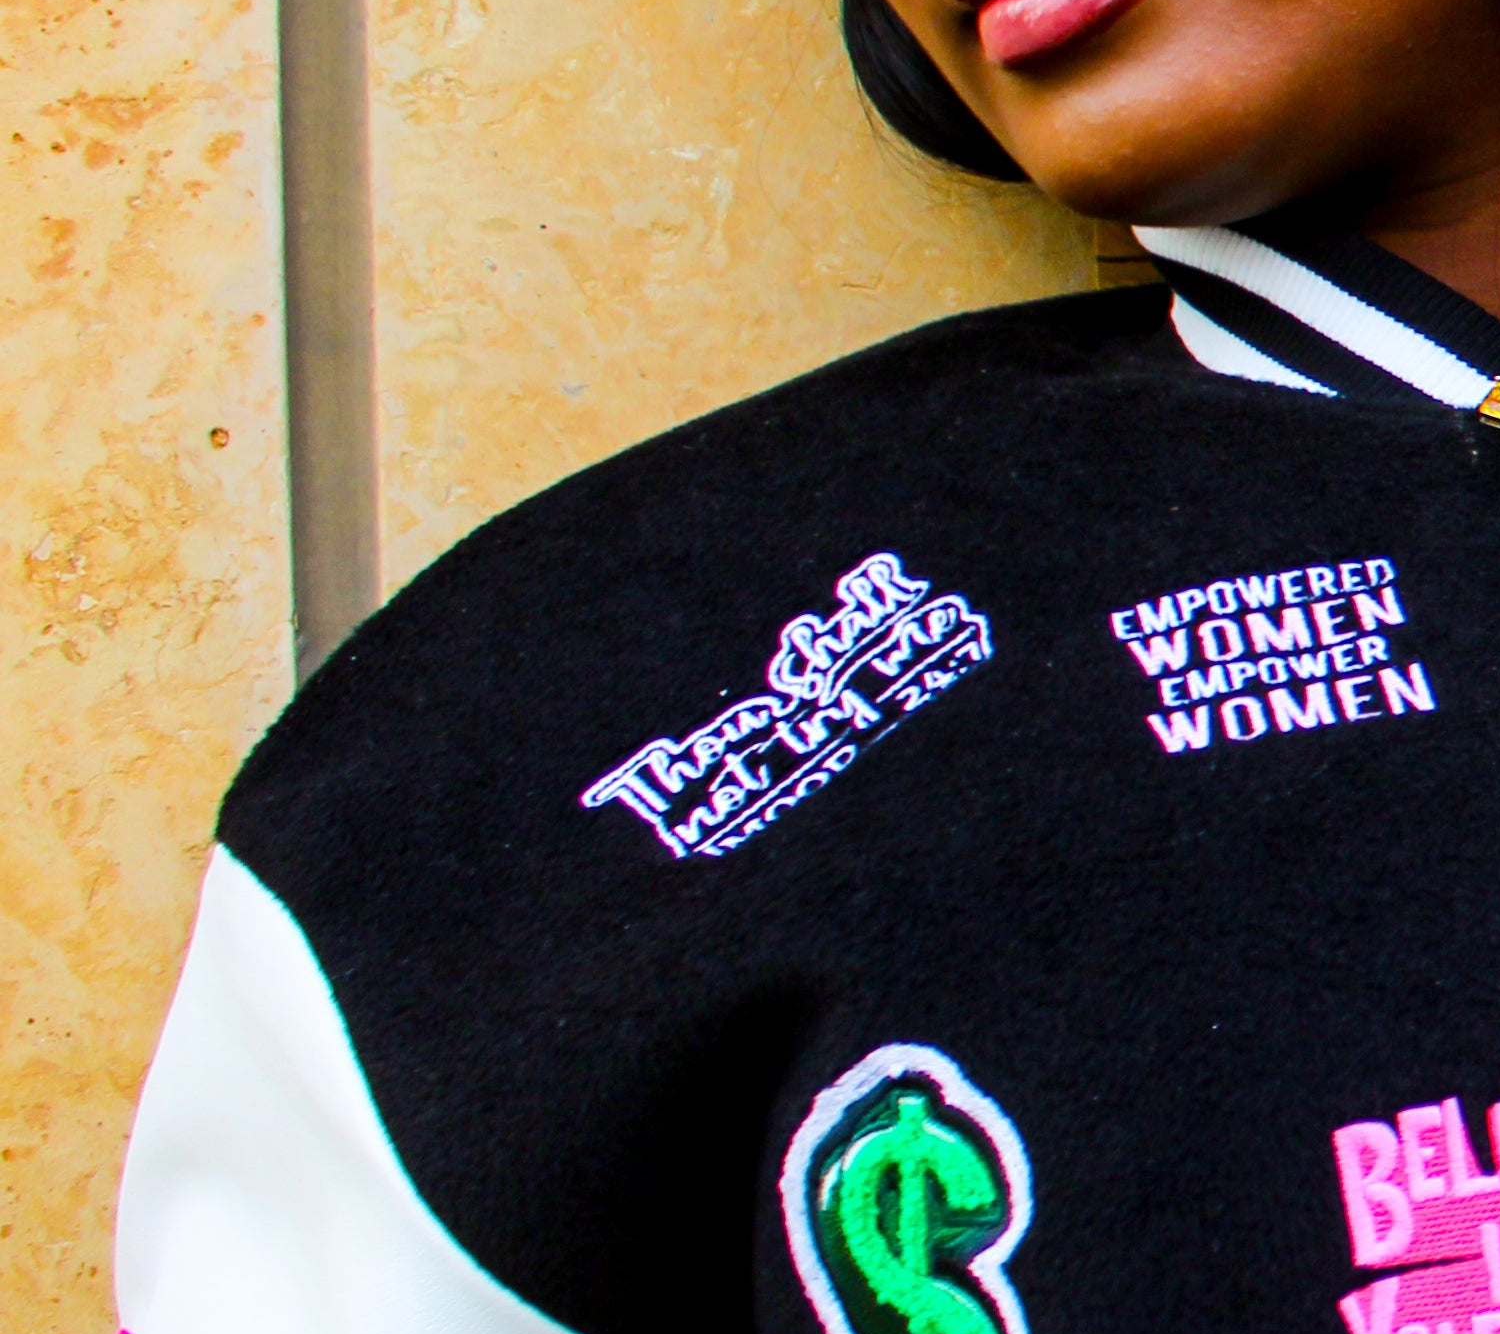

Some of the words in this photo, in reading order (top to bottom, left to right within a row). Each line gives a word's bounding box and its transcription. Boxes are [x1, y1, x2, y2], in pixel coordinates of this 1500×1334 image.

[1109, 558, 1396, 640] EMPOWERED
[1128, 586, 1407, 676] WOMEN
[586, 703, 777, 812] Thou
[780, 557, 922, 702] Shall
[1146, 662, 1436, 754] WOMEN
[1158, 635, 1390, 707] EMPOWER
[674, 743, 771, 844] not
[776, 687, 883, 755] try
